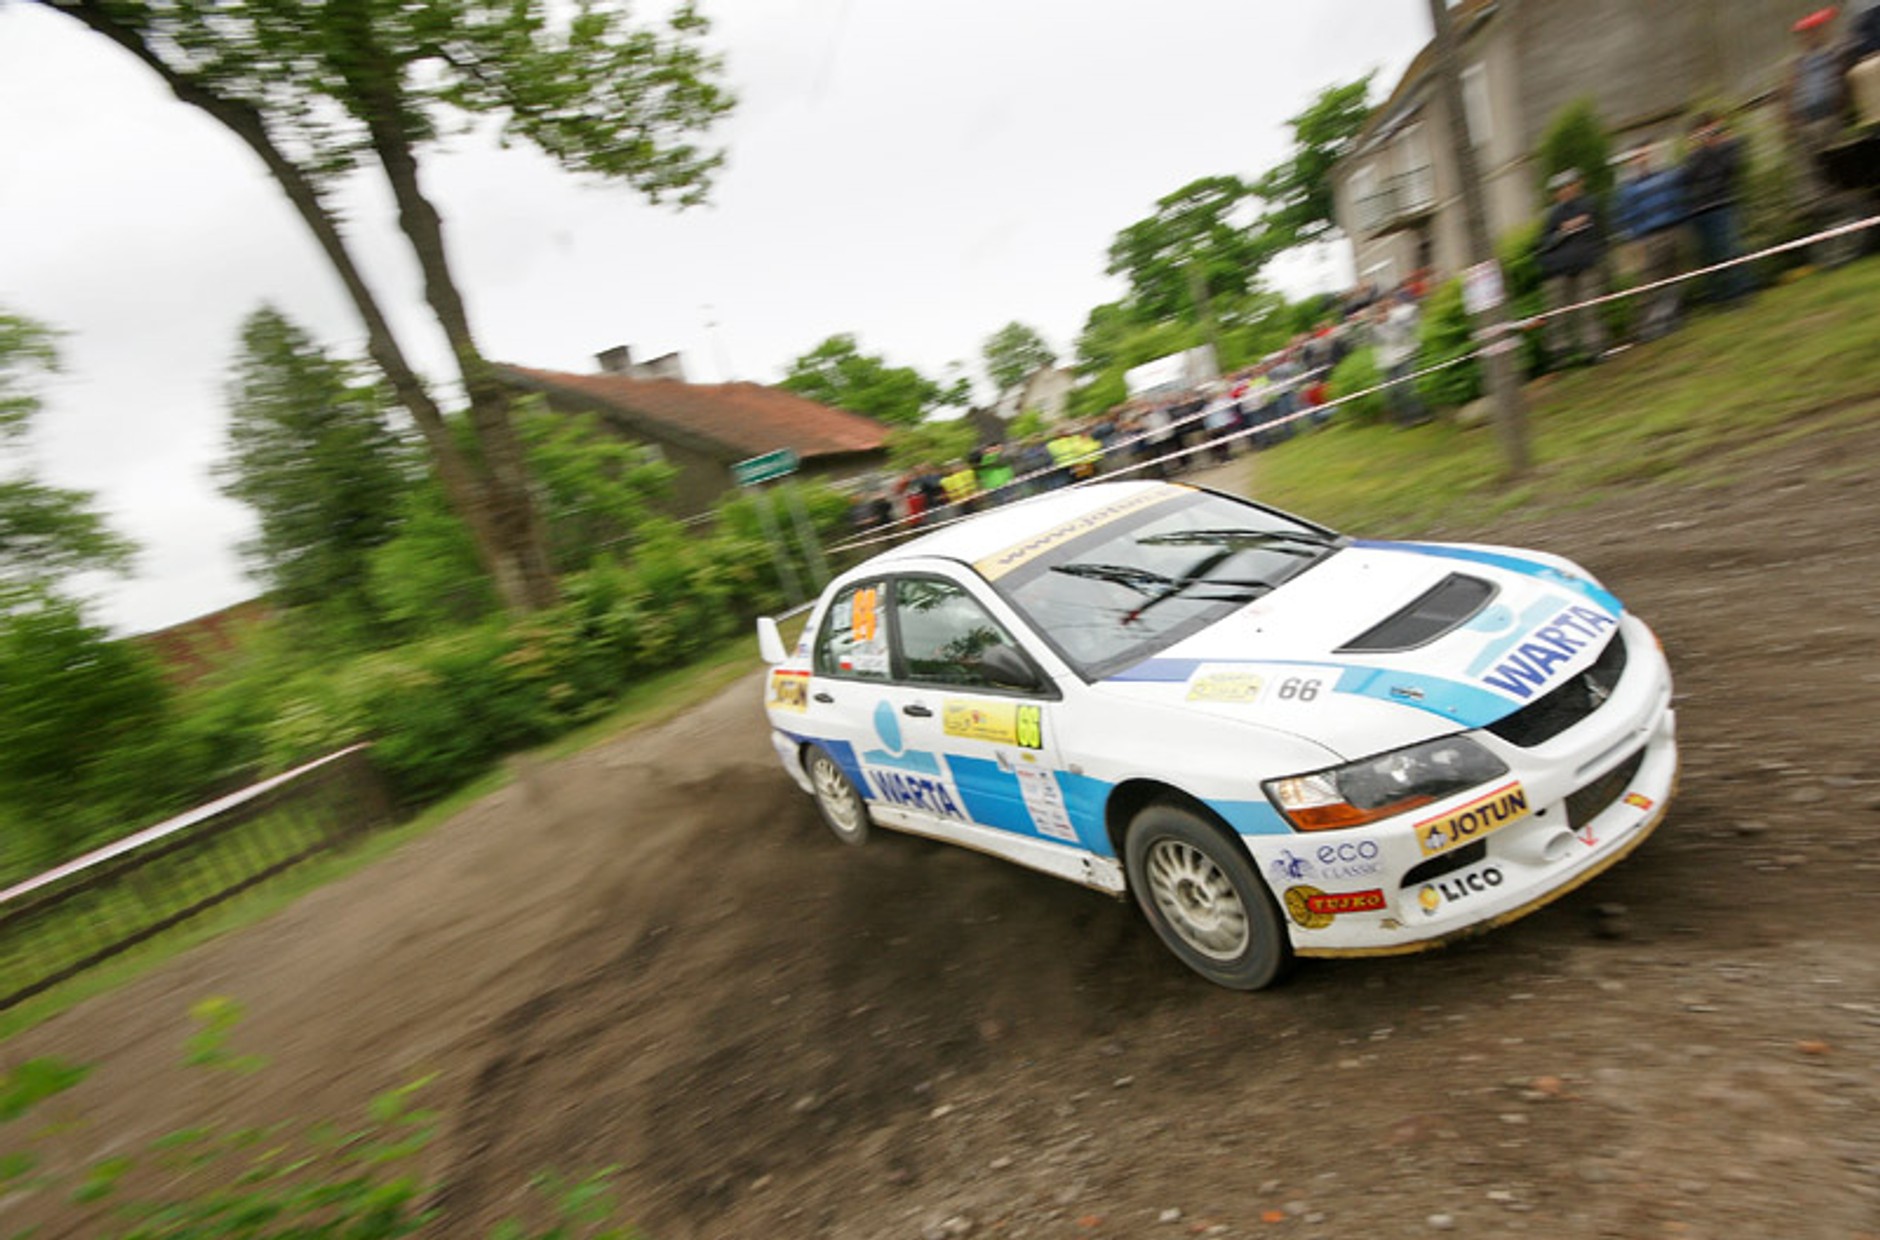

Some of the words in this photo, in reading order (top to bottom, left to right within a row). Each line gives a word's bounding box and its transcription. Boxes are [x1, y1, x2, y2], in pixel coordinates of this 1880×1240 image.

[1482, 605, 1616, 698] WARTA
[1278, 676, 1322, 703] 66
[869, 769, 967, 822] WARTA
[1449, 789, 1527, 842] JOTUN
[1316, 840, 1379, 865] eco
[1439, 867, 1503, 902] LICO
